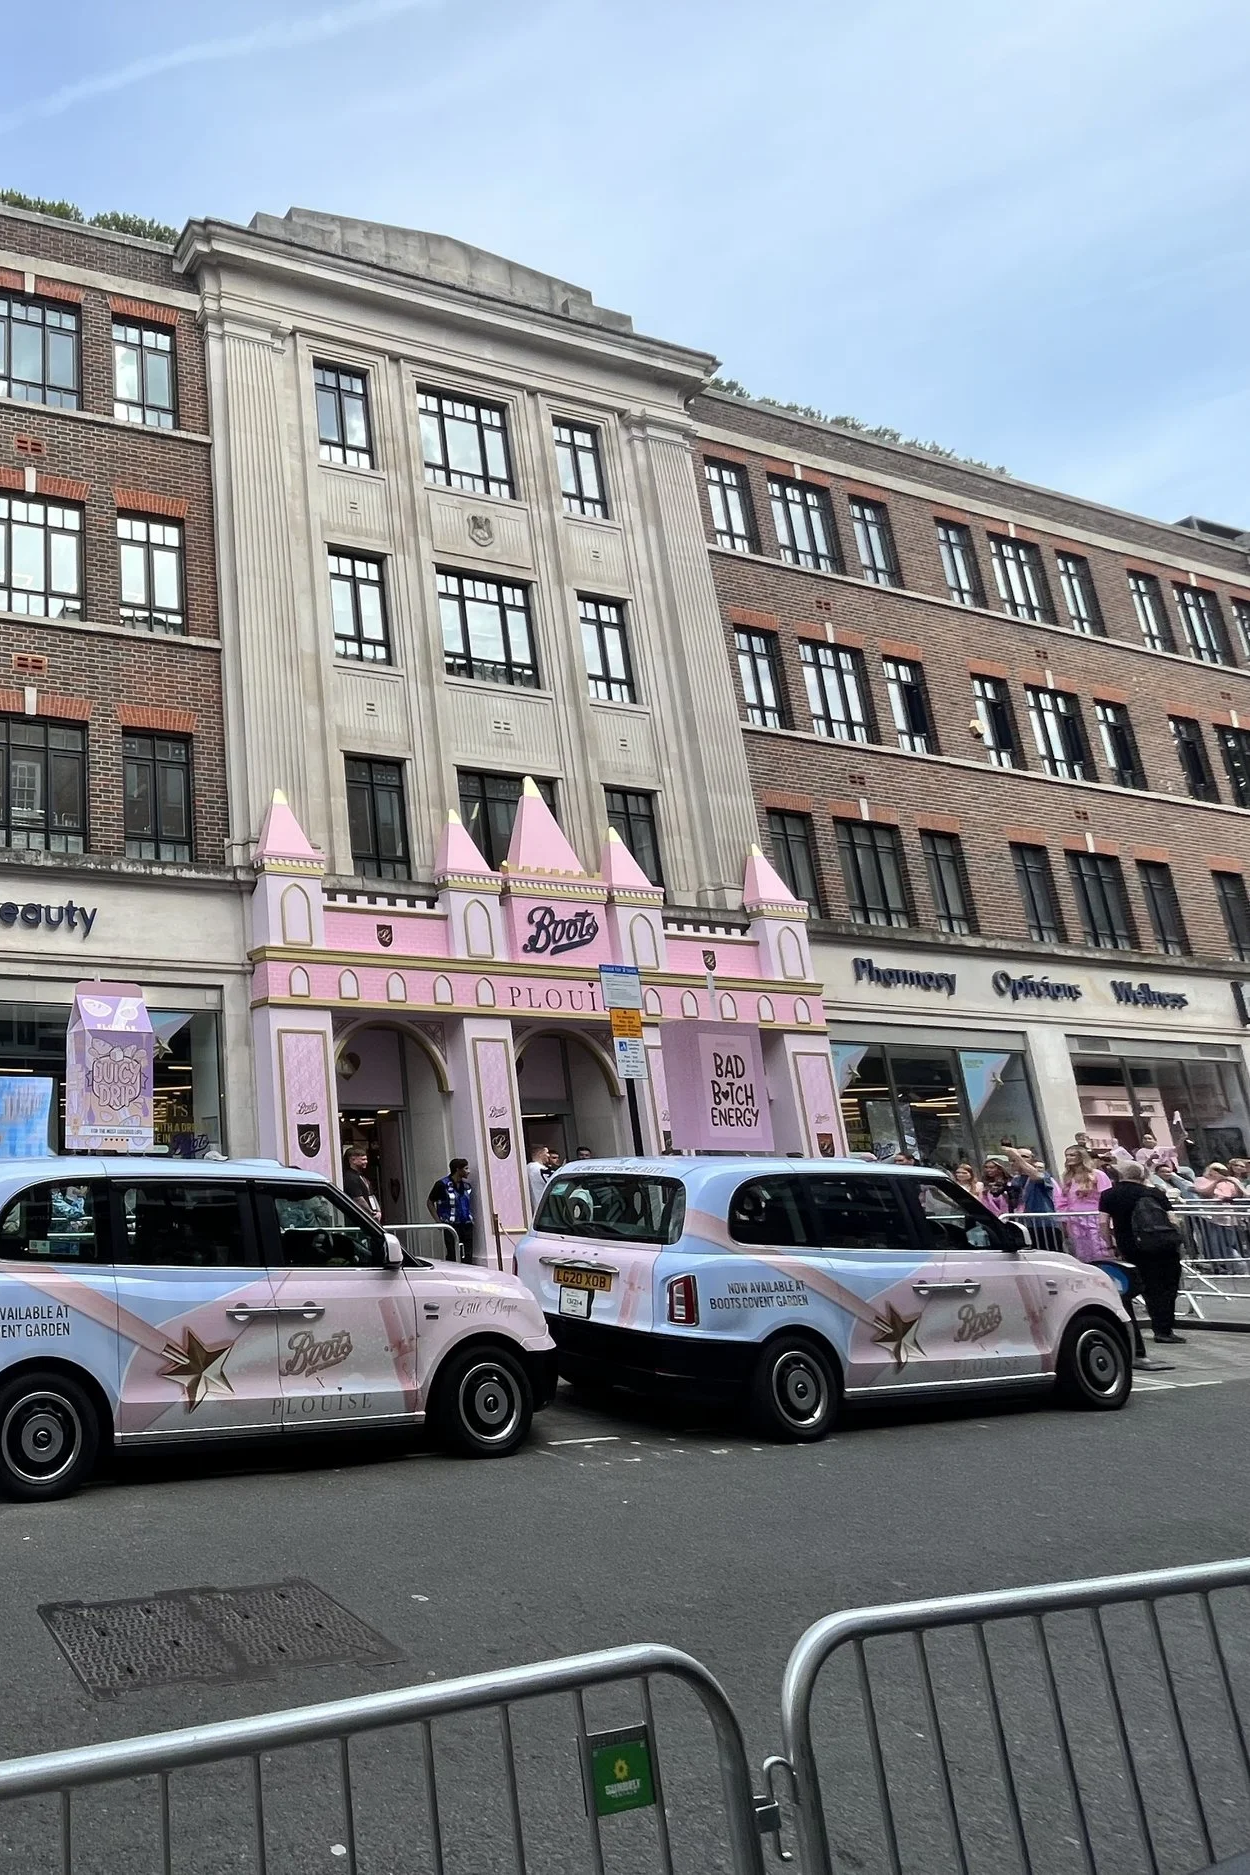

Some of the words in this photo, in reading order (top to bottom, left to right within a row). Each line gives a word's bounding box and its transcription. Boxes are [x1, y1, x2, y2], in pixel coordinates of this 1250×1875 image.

[522, 906, 599, 956] Boots
[852, 957, 957, 998] Pharmacy
[991, 970, 1082, 1001] Opticians
[1110, 980, 1189, 1009] Wellness
[508, 983, 607, 1011] PLOUI
[93, 1061, 141, 1084] JUICY
[712, 1052, 746, 1079] BAD
[98, 1083, 137, 1107] DRIP
[711, 1107, 760, 1127] ENERGY
[556, 1270, 583, 1284] LG20
[585, 1273, 607, 1288] XOB
[727, 1282, 748, 1294] NOW
[750, 1280, 793, 1293] AVAILABLE
[795, 1279, 805, 1291] AT
[56, 1304, 70, 1318] AT
[709, 1297, 741, 1310] BOOTS
[742, 1296, 776, 1308] COVENT
[777, 1294, 809, 1307] GARDEN
[25, 1322, 70, 1337] GARDEN
[953, 1303, 1002, 1343] Boots
[279, 1330, 354, 1377] Boots
[270, 1392, 373, 1416] PLOUISE
